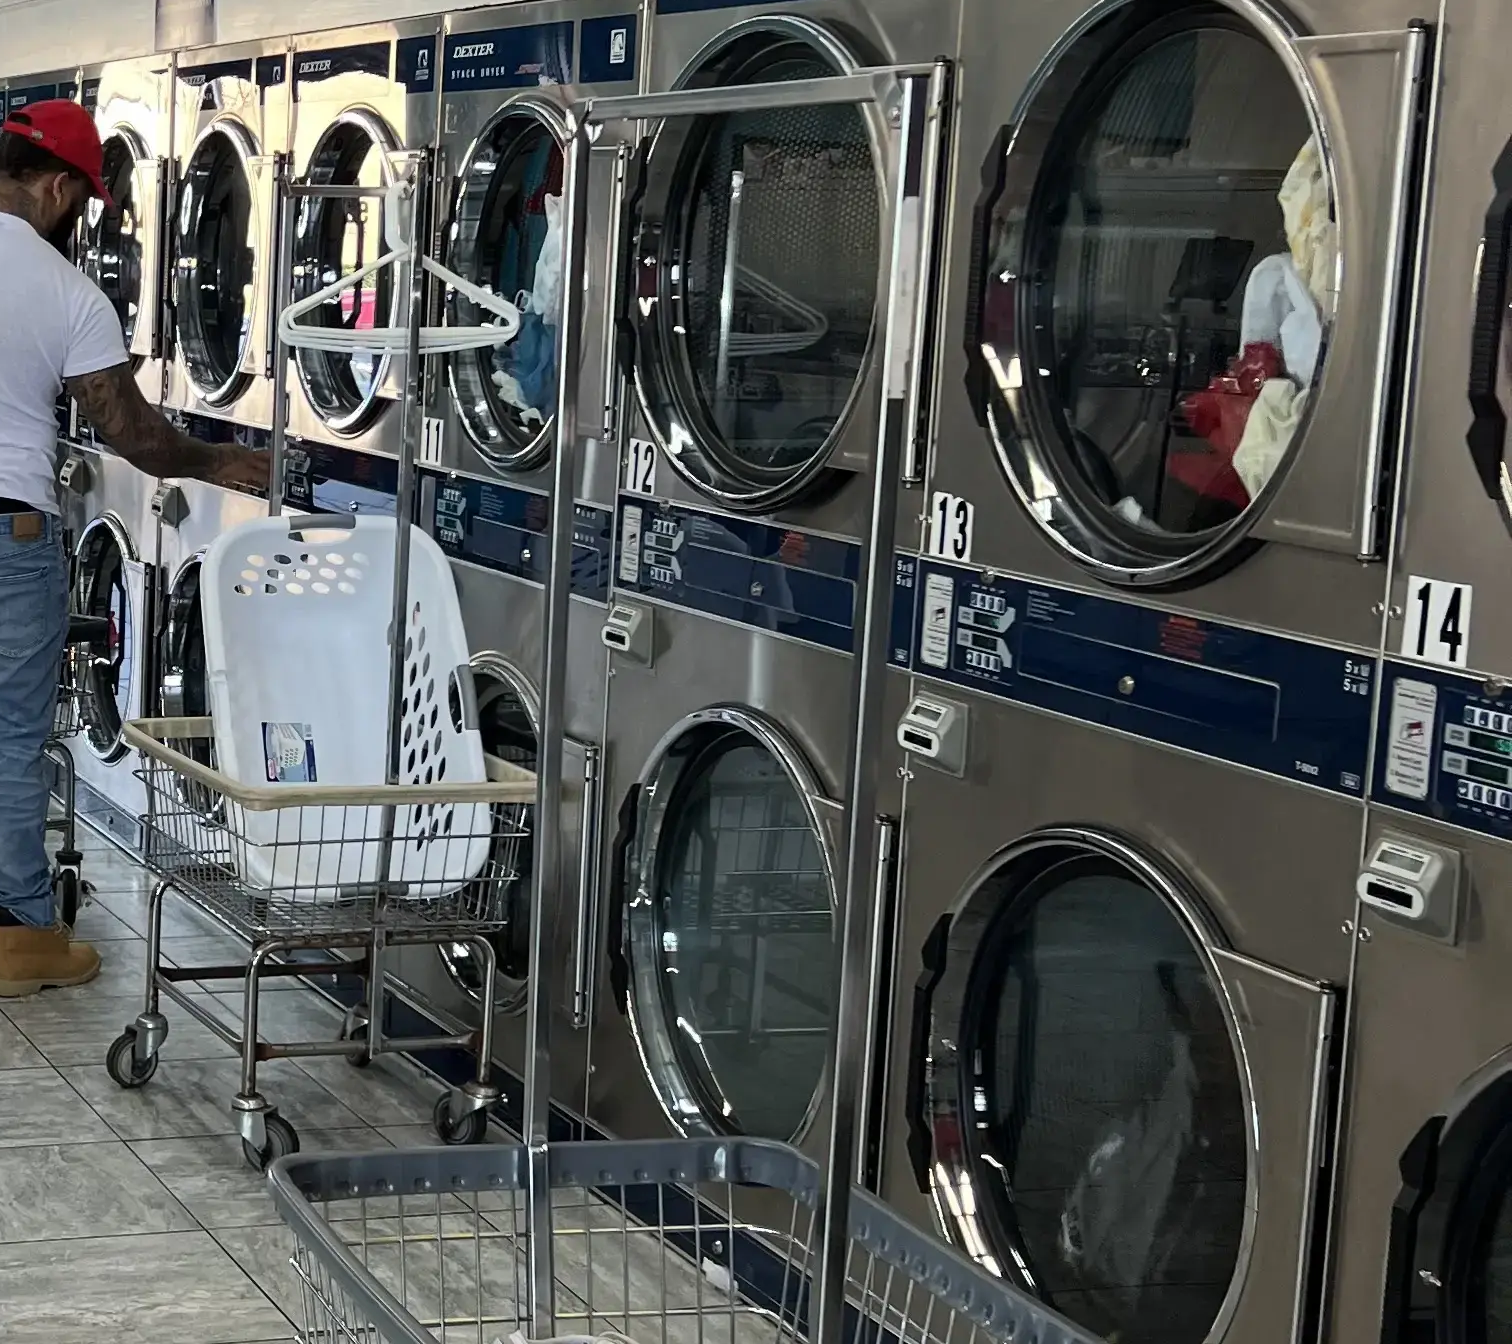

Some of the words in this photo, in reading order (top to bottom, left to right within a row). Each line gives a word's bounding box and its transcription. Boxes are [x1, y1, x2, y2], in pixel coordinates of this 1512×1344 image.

[299, 59, 332, 73] DEXTER
[451, 68, 475, 80] STACK
[480, 66, 505, 78] DRYER
[453, 43, 495, 58] DEXTER
[425, 418, 441, 463] 11
[633, 442, 655, 493] 12
[938, 495, 968, 559] 13
[1417, 582, 1463, 662] 14
